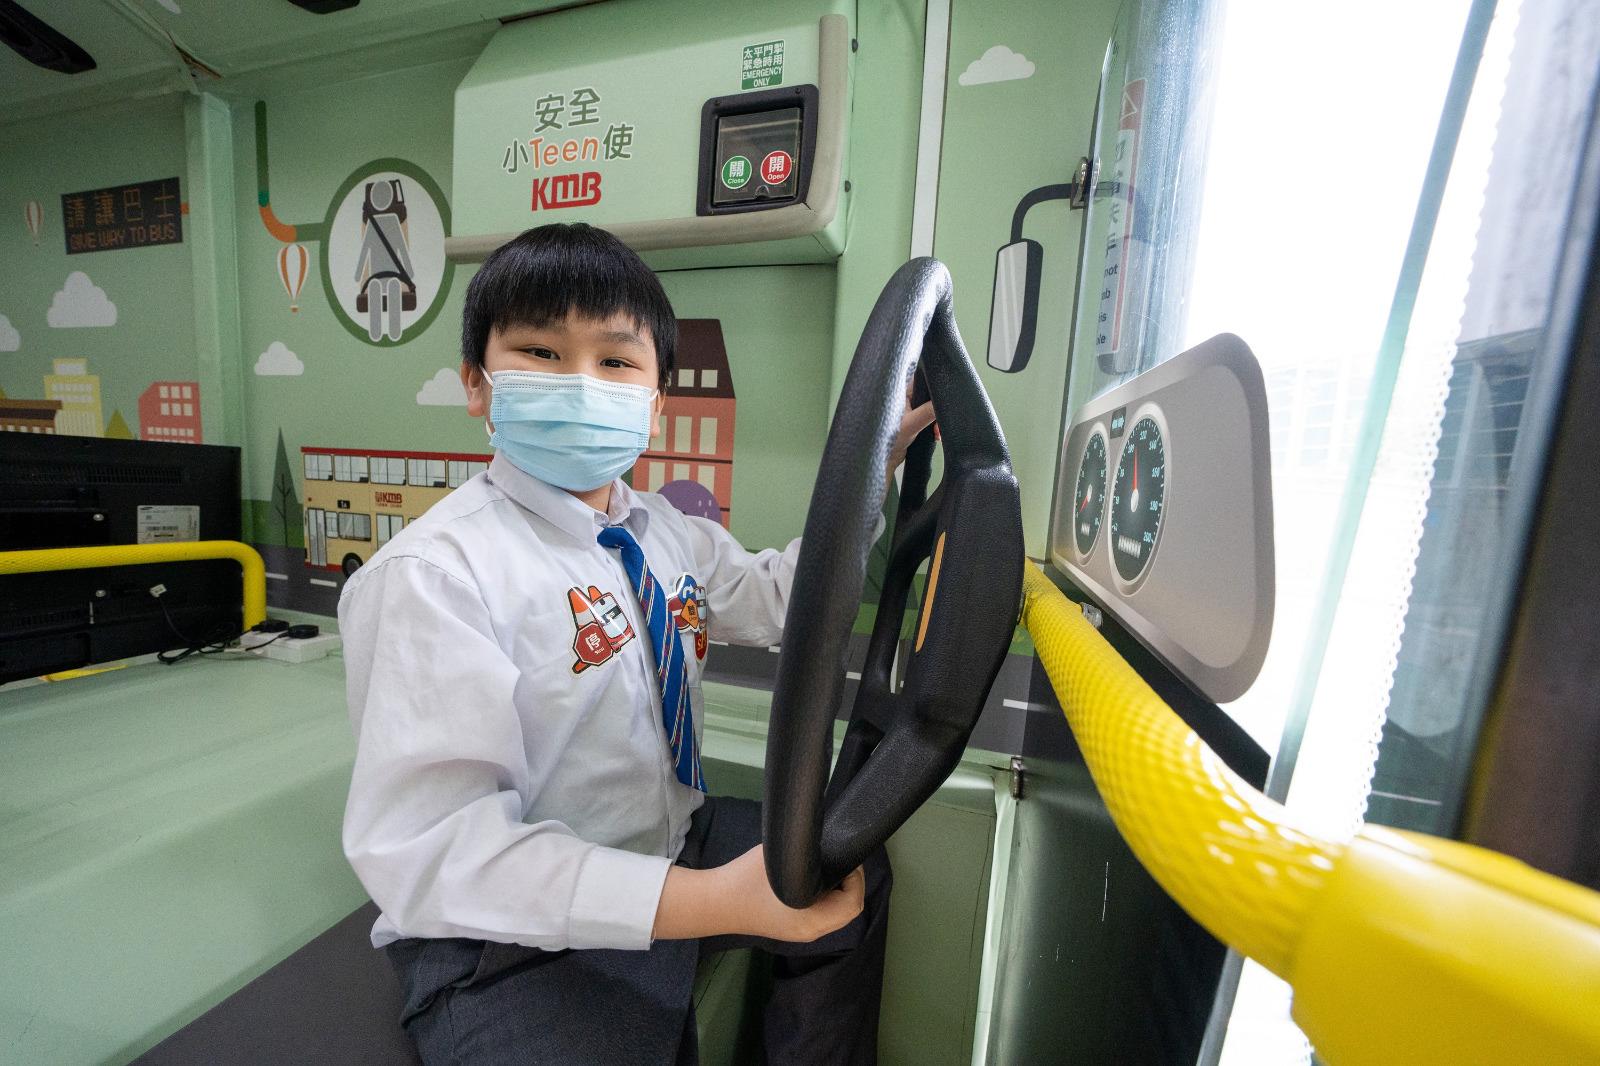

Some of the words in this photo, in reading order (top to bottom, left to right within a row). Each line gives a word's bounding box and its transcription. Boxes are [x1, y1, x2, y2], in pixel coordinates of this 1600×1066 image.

[743, 53, 783, 71] 緊急時用
[742, 65, 783, 80] EMERGENCY
[753, 76, 771, 87] ONLY
[534, 88, 601, 133] 安全
[768, 155, 785, 173] 開
[70, 232, 97, 250] GIVE
[99, 229, 125, 247] WAY
[129, 225, 146, 243] TO
[149, 222, 177, 242] BUS
